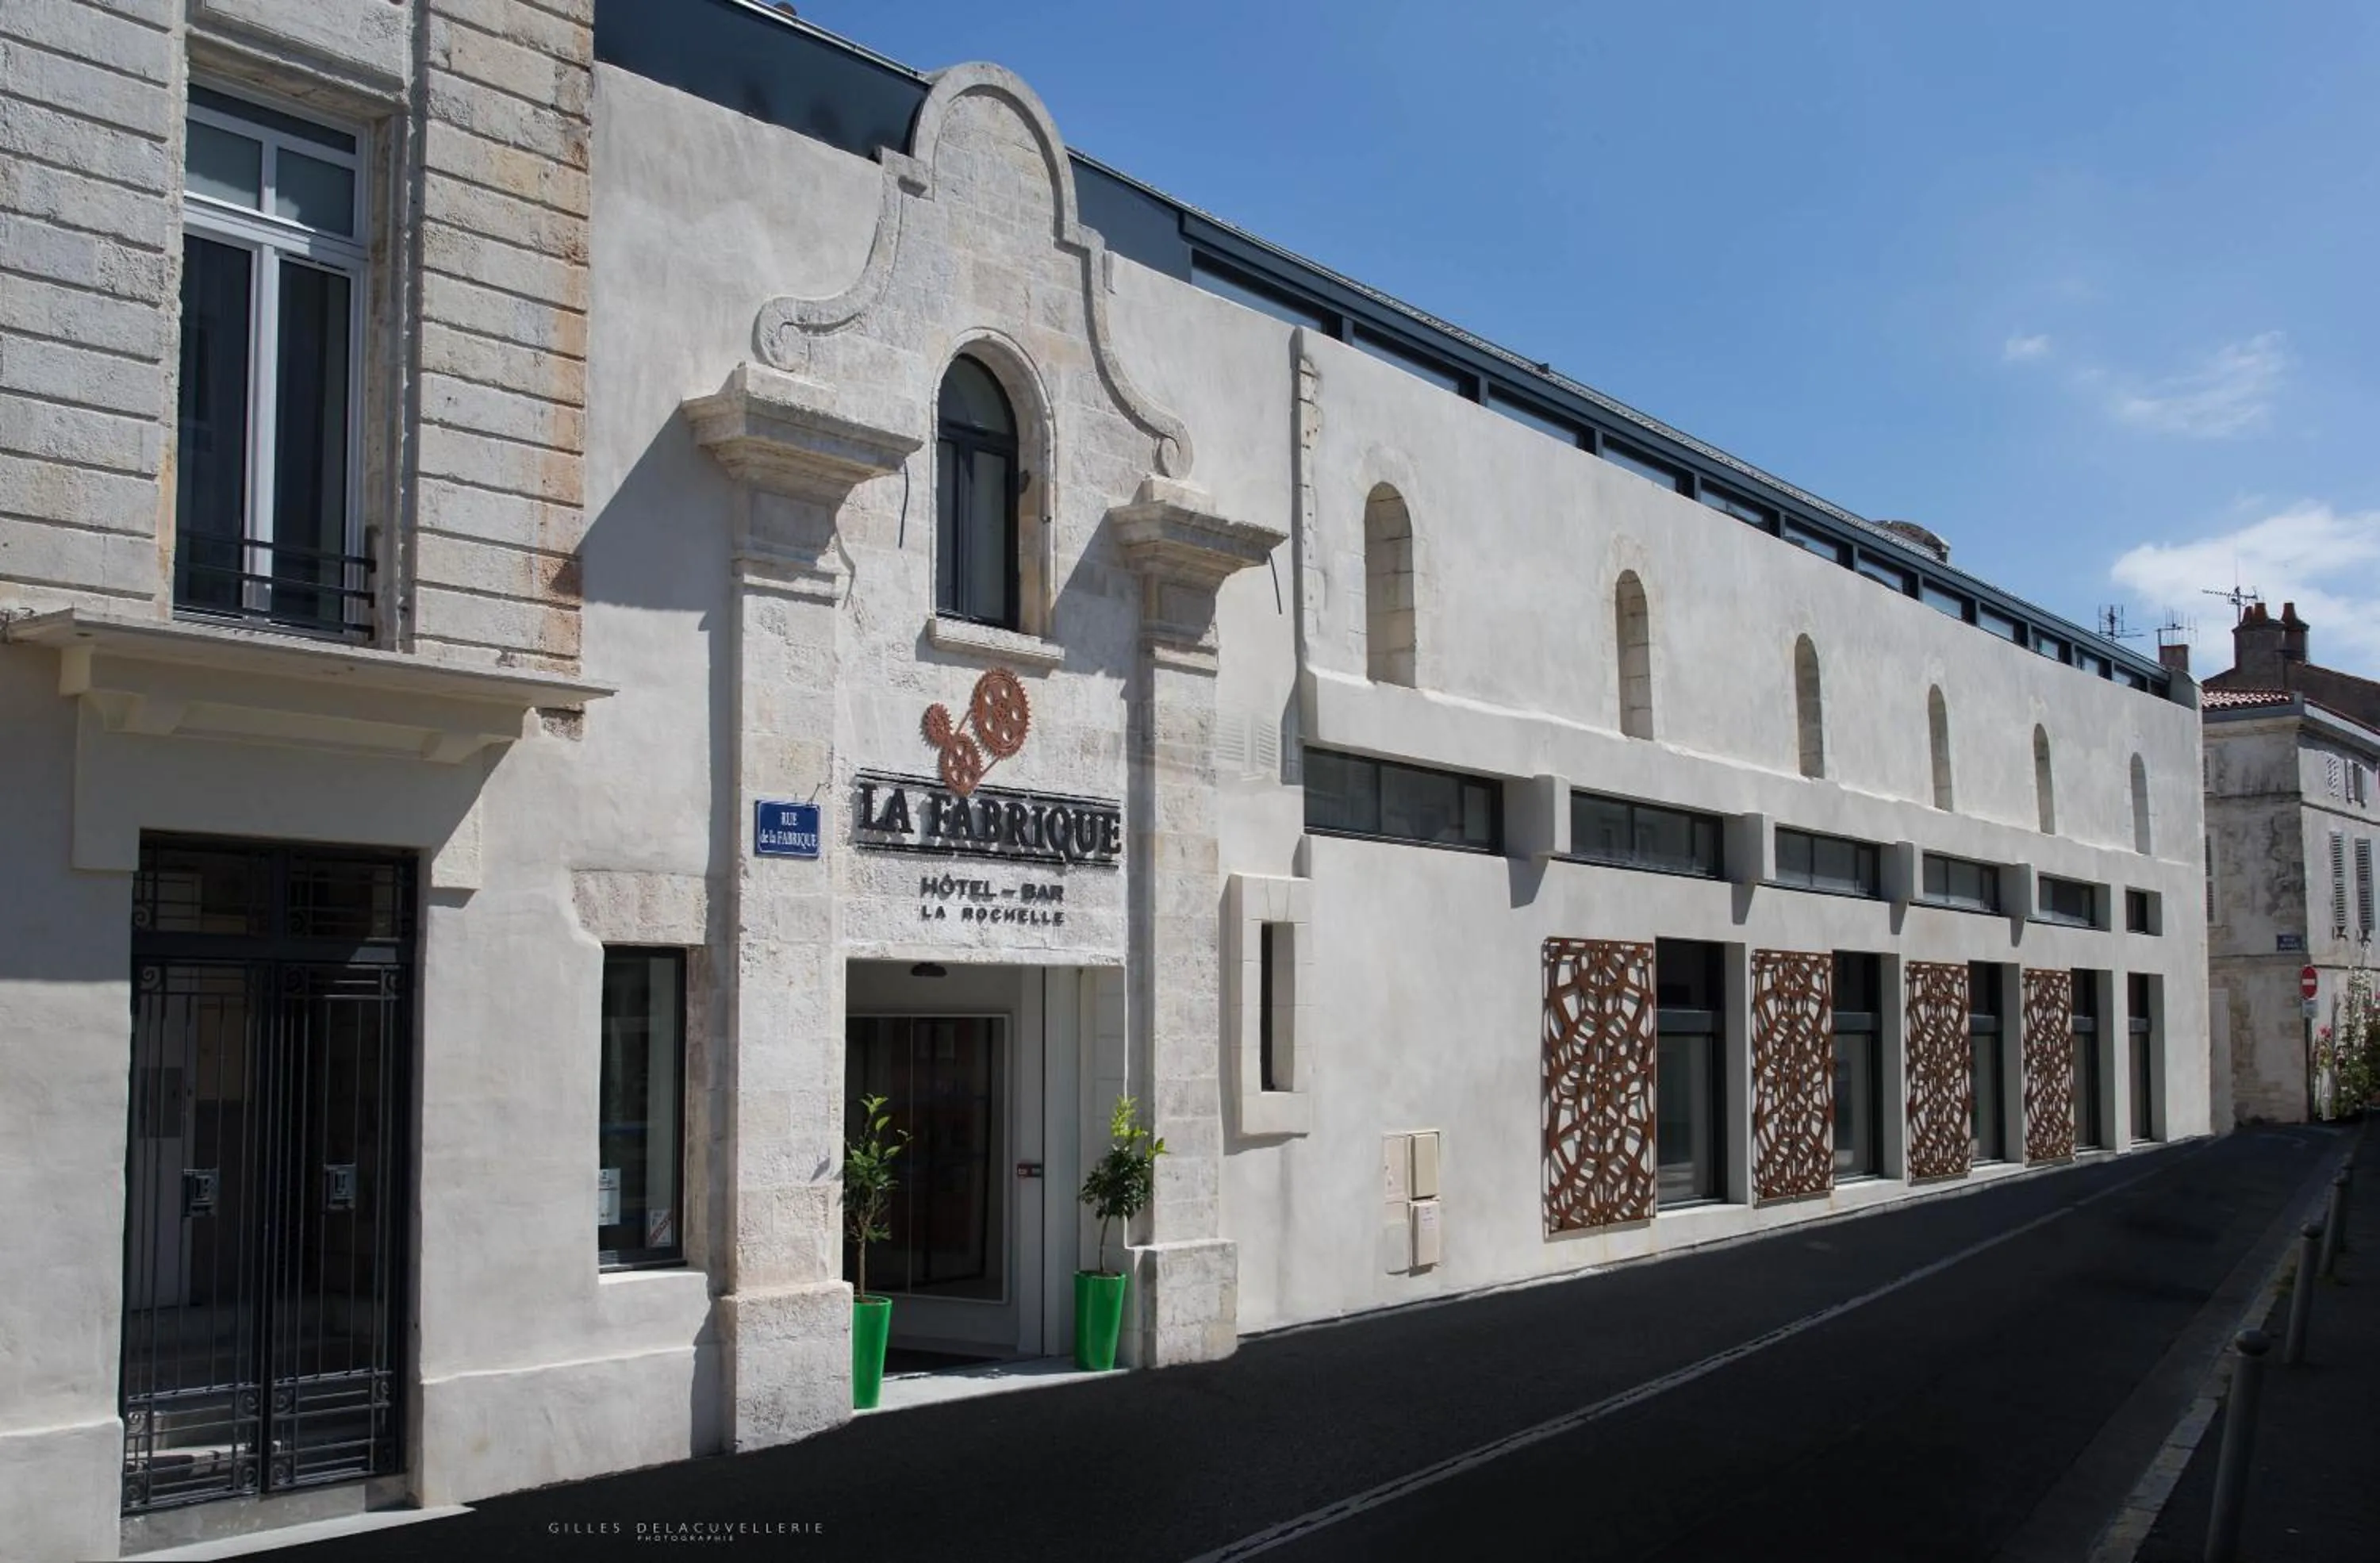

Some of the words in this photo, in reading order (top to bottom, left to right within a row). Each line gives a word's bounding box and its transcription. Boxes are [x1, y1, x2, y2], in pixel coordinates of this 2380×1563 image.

[781, 812, 798, 826] RUE
[858, 782, 914, 834] LA
[928, 792, 1122, 865] FABRIQUE
[761, 829, 769, 843] de
[770, 830, 777, 843] la
[777, 831, 817, 850] FABRIQUE
[920, 874, 996, 900] HÔTEL
[1022, 883, 1064, 903] BAR
[920, 905, 946, 920] LA
[962, 908, 1065, 927] ROCHELLE
